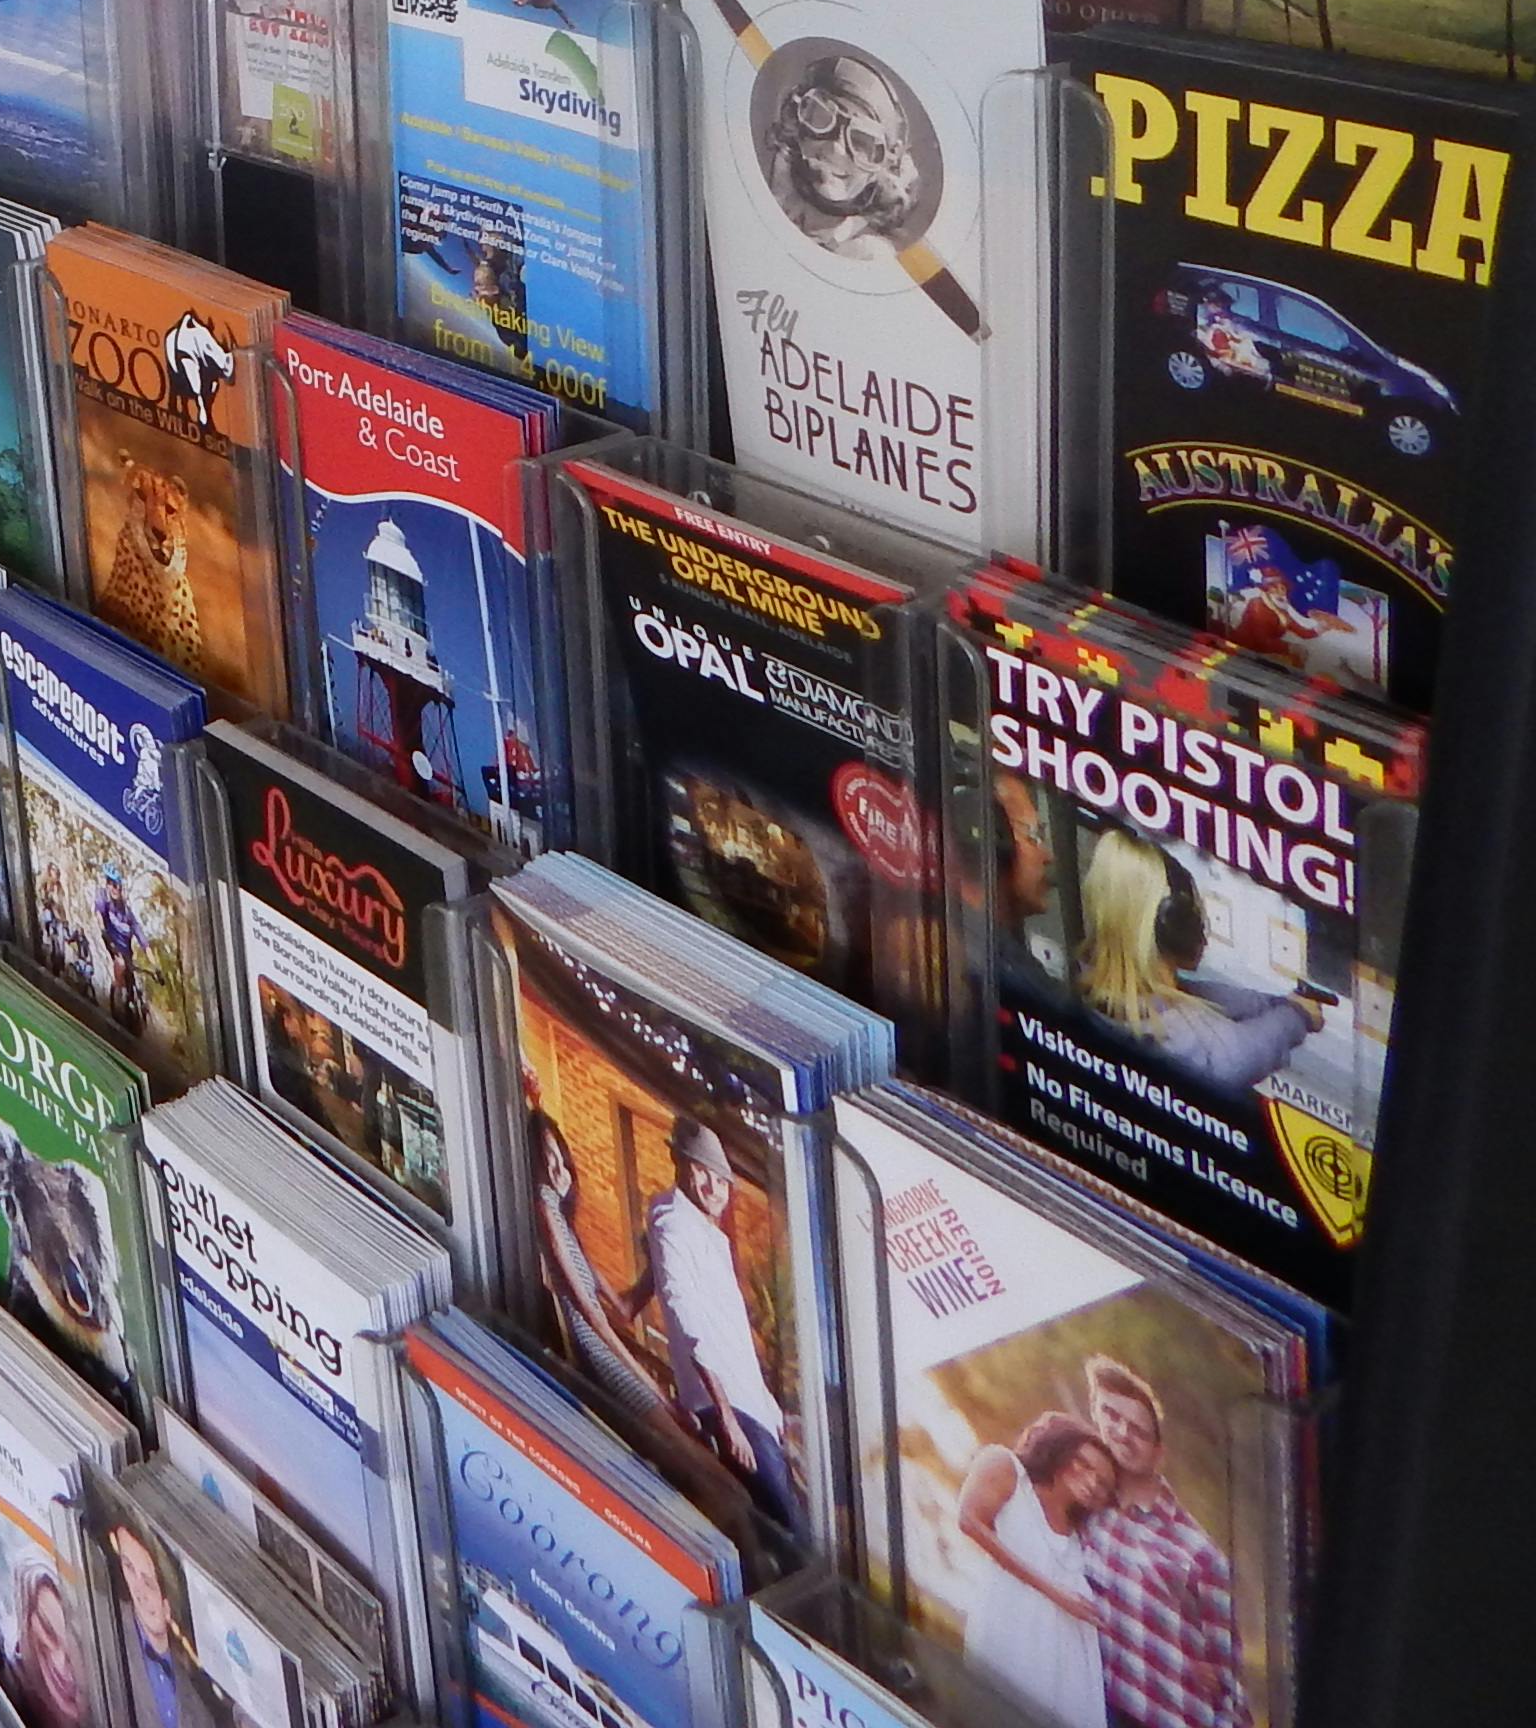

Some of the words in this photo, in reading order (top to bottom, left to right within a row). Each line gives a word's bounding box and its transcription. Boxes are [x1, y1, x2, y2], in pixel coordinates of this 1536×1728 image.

[487, 52, 530, 75] Adelaide
[532, 63, 571, 85] Tandem
[519, 78, 621, 137] Skydiving
[400, 175, 428, 192] Come
[431, 179, 458, 203] jump
[459, 192, 470, 205] at
[472, 196, 504, 216] South
[506, 204, 561, 234] Australia's
[400, 195, 440, 215] running
[443, 205, 493, 231] Skydiving
[1090, 70, 1511, 288] PIZZA
[401, 226, 442, 247] regions.
[401, 209, 417, 223] the
[479, 233, 524, 256] Barossa
[540, 250, 568, 271] Clare
[570, 260, 602, 284] Valley
[433, 318, 495, 367] from
[736, 289, 799, 338] Fly
[106, 392, 126, 410] on
[127, 395, 154, 422] the
[156, 408, 201, 444] WILD
[287, 347, 334, 396] Port
[338, 373, 445, 440] Adelaide
[760, 329, 975, 452] ADELAIDE
[358, 418, 378, 451] &
[384, 428, 461, 483] Coast
[764, 385, 979, 515] BIPLANES
[673, 506, 717, 536] FREE
[719, 521, 772, 556] ENTRY
[1133, 448, 1455, 599] AUSTRALIA'S
[601, 505, 655, 545] THE
[657, 528, 882, 641] UNDERGROUND
[672, 555, 745, 603] OPAL
[748, 588, 825, 638] MINE
[627, 595, 756, 662] UNIQUE
[633, 613, 766, 704] OPAL
[0, 631, 126, 766] escapegoat
[32, 695, 106, 768] adventures
[986, 645, 1104, 737] TRY
[1120, 700, 1355, 846] PISTOL
[989, 714, 1357, 917] SHOOTING!
[251, 785, 406, 971] Luxury
[251, 907, 316, 964] Specialising
[316, 947, 326, 966] in
[326, 953, 366, 995] luxury
[367, 978, 390, 1007] day
[390, 992, 423, 1033] tours
[252, 927, 272, 948] the
[272, 939, 318, 980] Barossa
[320, 967, 357, 1006] Valley,
[358, 995, 417, 1045] Hahndorf
[273, 958, 341, 1020] surrounding
[341, 999, 394, 1047] Adelaide
[395, 1038, 424, 1070] Hills.
[1017, 1010, 1117, 1086] Visitors
[1120, 1064, 1249, 1153] Welcome
[1026, 1060, 1063, 1099] No
[1068, 1084, 1185, 1167] Firearms
[1190, 1147, 1298, 1229] Licence
[1029, 1098, 1149, 1183] Required
[160, 1158, 258, 1263] outlet
[884, 1214, 959, 1275] CREEK
[940, 1205, 1007, 1298] REGION
[167, 1201, 343, 1377] shopping
[906, 1257, 987, 1322] WINE
[489, 1414, 505, 1429] OF
[506, 1424, 526, 1448] THE
[529, 1446, 583, 1496] COORONG
[459, 1448, 684, 1670] Coorong
[529, 1567, 566, 1609] from
[565, 1600, 617, 1652] Goolwa
